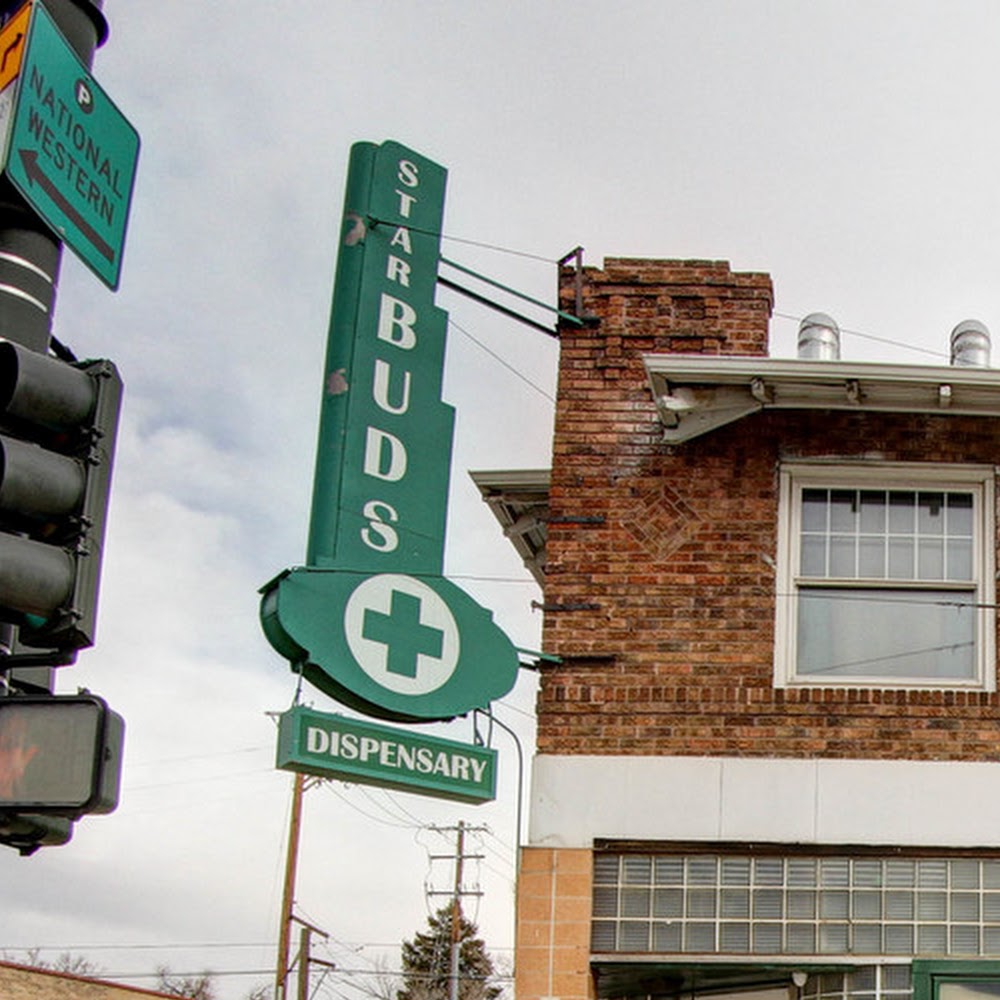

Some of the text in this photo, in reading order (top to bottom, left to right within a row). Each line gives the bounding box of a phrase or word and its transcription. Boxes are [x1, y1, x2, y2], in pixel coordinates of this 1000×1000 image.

[27, 105, 116, 227] WESTERN
[29, 64, 123, 199] NATIONAL
[306, 726, 487, 783] DISPENSARY
